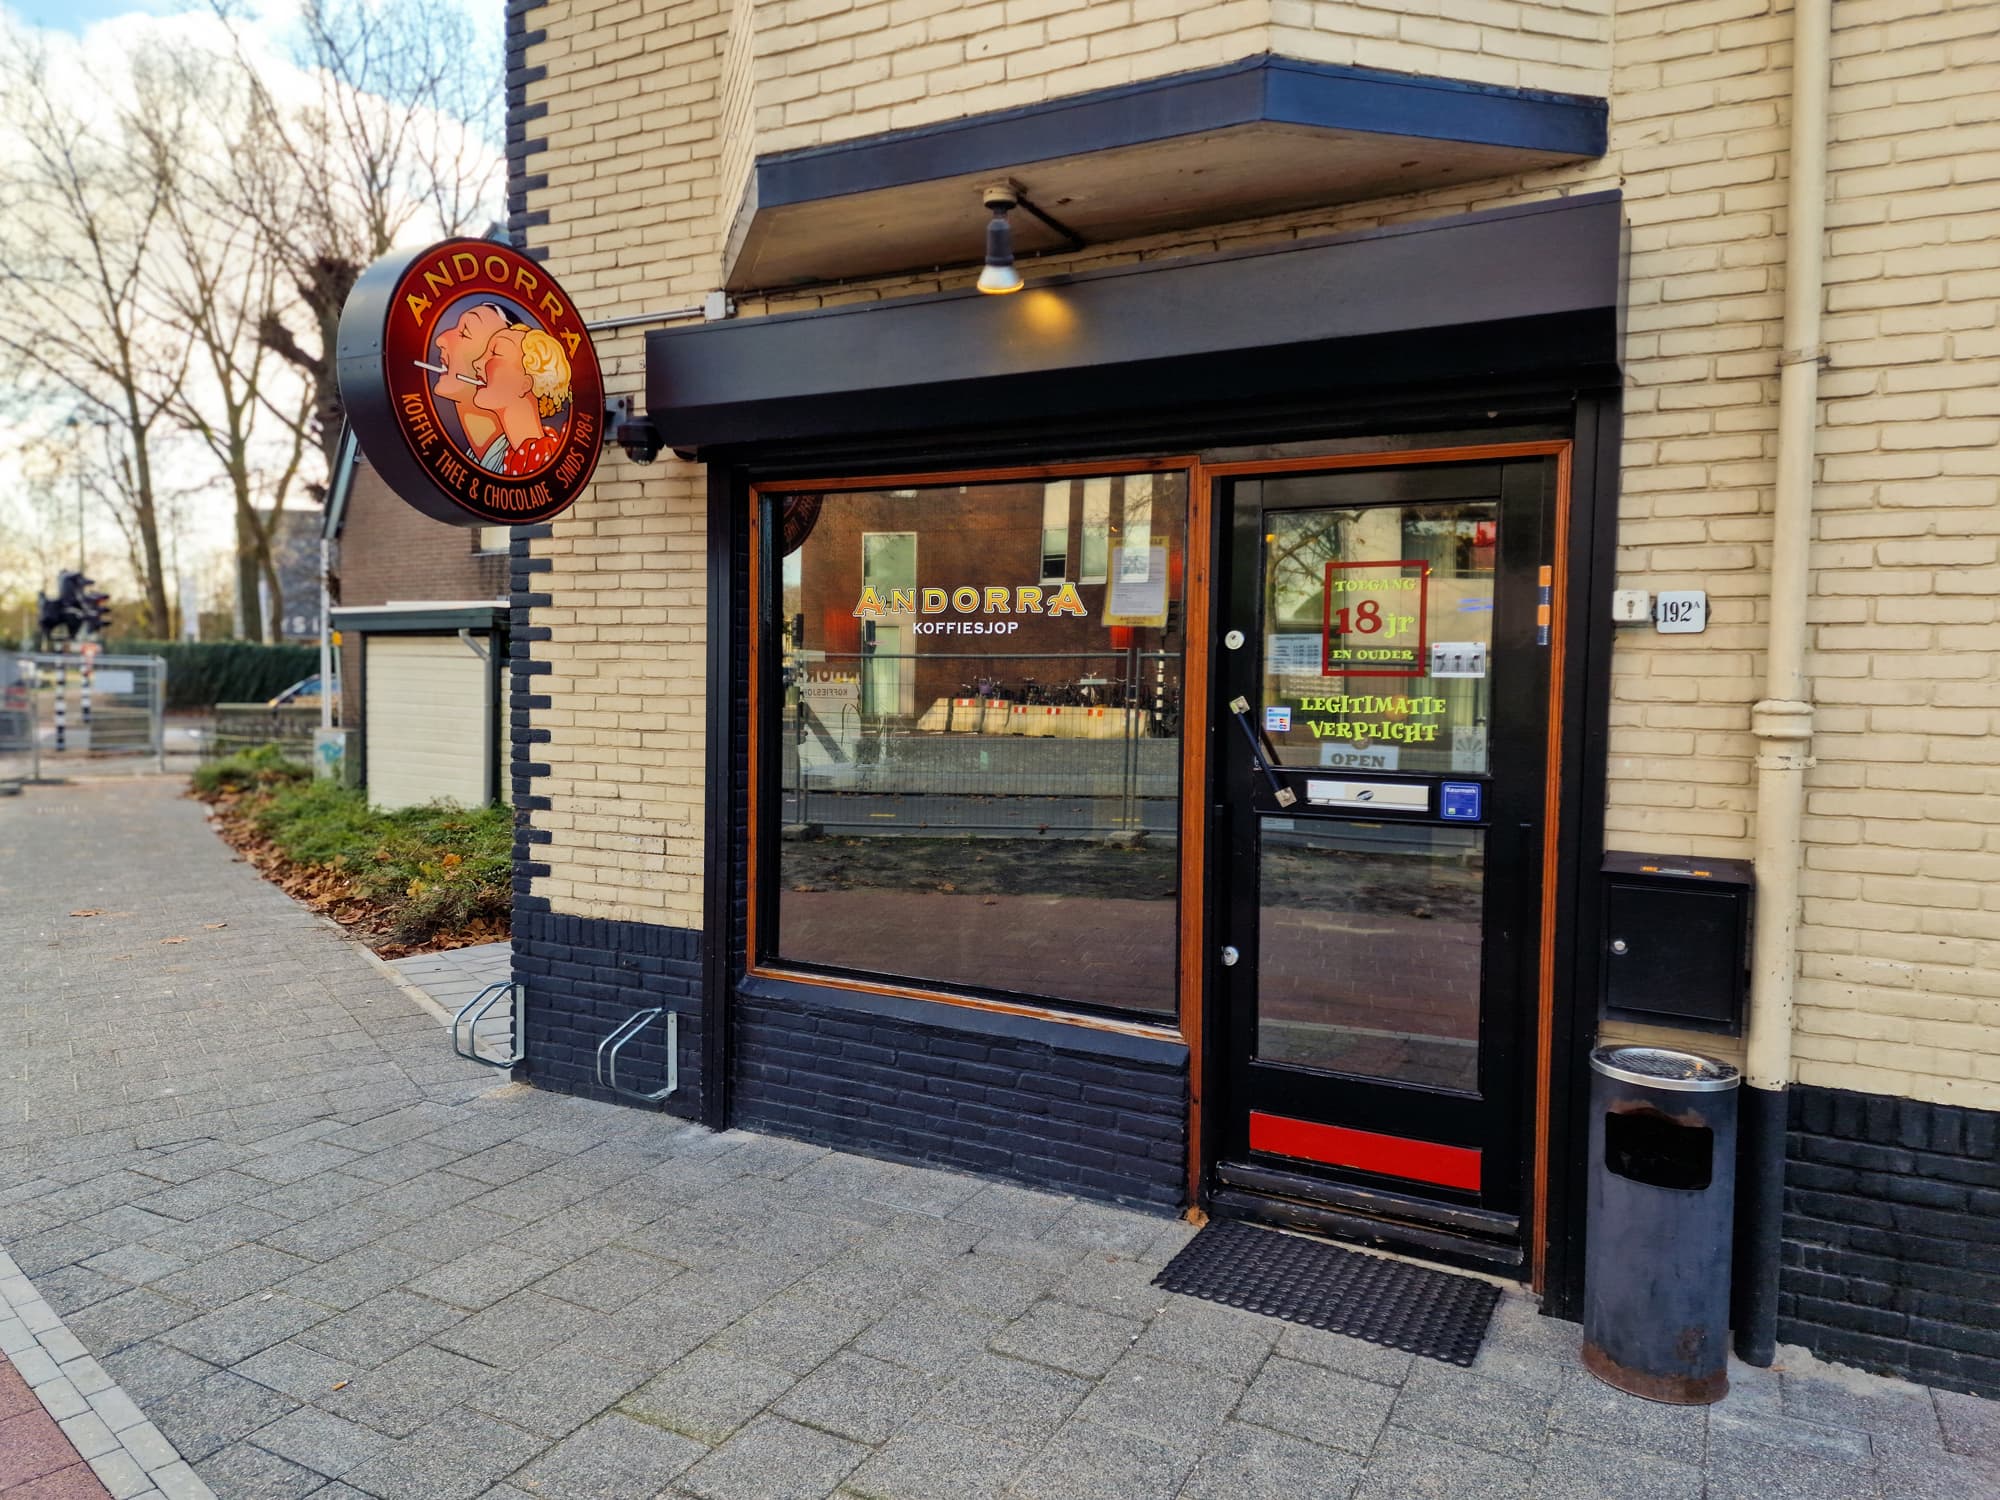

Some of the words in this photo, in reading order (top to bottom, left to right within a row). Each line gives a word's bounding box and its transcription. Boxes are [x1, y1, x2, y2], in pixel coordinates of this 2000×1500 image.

[406, 252, 581, 359] ANDORRA
[402, 393, 438, 456] KOFFIE,
[435, 449, 468, 490] THEE
[469, 478, 478, 500] &
[484, 481, 552, 511] CHOCOLADE
[556, 447, 584, 489] SINDS
[574, 412, 594, 448] 1984
[1335, 579, 1416, 592] TOEGANG
[852, 582, 1088, 616] ANDORRA
[912, 622, 1019, 635] KOFFIESJOP
[1335, 600, 1383, 634] 18
[1384, 613, 1415, 639] jr
[1333, 649, 1352, 660] EN
[1357, 649, 1414, 660] OUDER
[1300, 695, 1447, 715] LEGITIMATIE
[1306, 720, 1439, 743] VERPLICHT
[1331, 752, 1386, 768] OPEN
